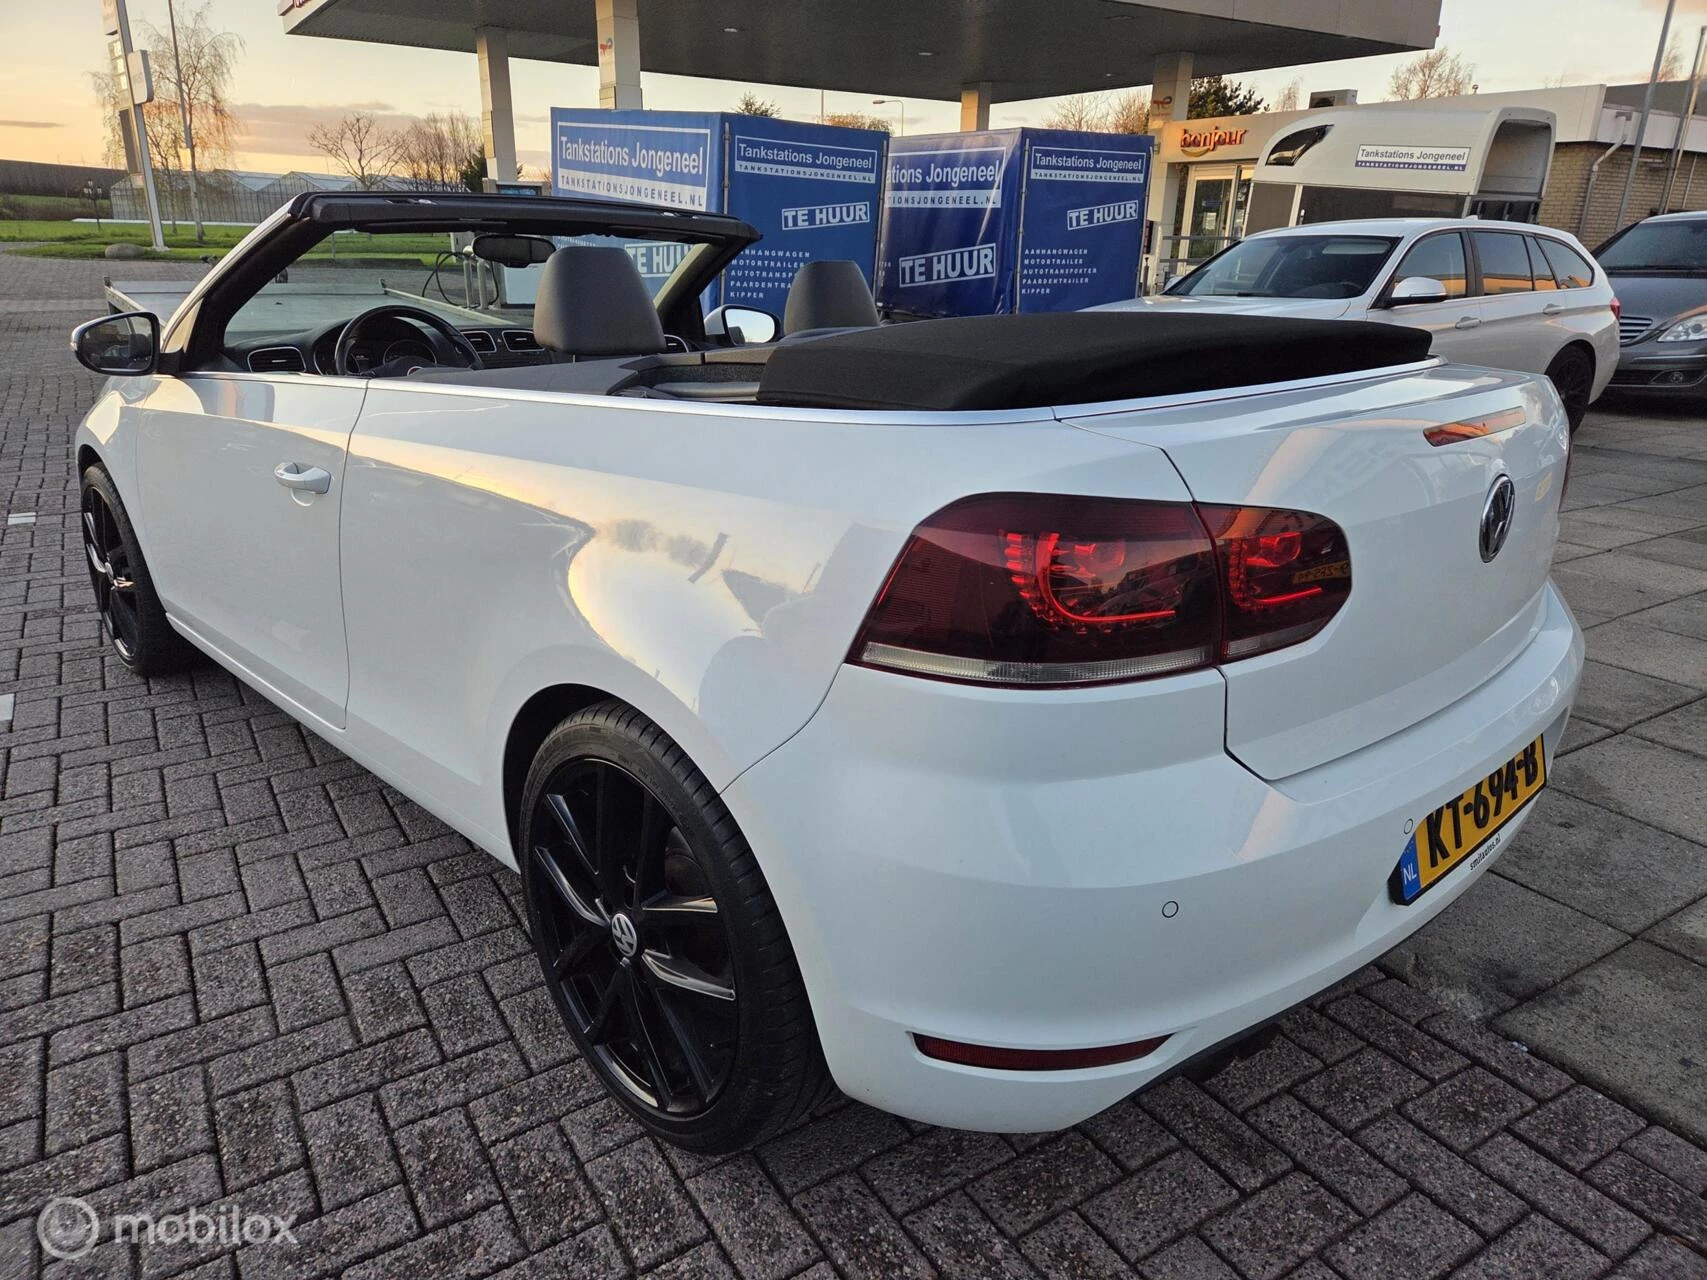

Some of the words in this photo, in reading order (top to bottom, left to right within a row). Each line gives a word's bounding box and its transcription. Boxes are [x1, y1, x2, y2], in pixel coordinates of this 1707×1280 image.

[1180, 126, 1248, 152] bonjour
[560, 136, 629, 167] Tankstations
[631, 142, 703, 178] Jongeneel
[738, 143, 813, 164] Tankstations
[815, 152, 872, 170] Jongeneel
[1035, 153, 1094, 168] Tankstations
[1096, 157, 1142, 172] Jongeneel
[1360, 148, 1415, 160] Tankstations
[1416, 151, 1466, 162] Jongeneel
[738, 164, 872, 182] TANKSTATIONSJONGENEEL.NL
[886, 164, 923, 184] ations
[925, 160, 1000, 188] Jongeneel
[561, 175, 703, 207] TANKSTATIONSJONGENEEL.NL
[783, 209, 809, 228] TE
[815, 204, 868, 226] HUUR
[1069, 210, 1089, 228] TE
[1093, 203, 1137, 224] HUUR
[740, 248, 810, 258] NHANGWAGEN
[730, 269, 793, 279] AUTOTRANSP
[901, 258, 926, 283] TE
[932, 248, 994, 280] HUUR
[730, 281, 792, 289] PAARDENTRA
[730, 291, 764, 299] KIPPER
[1425, 740, 1539, 869] KT-694-B
[1402, 863, 1418, 887] NL
